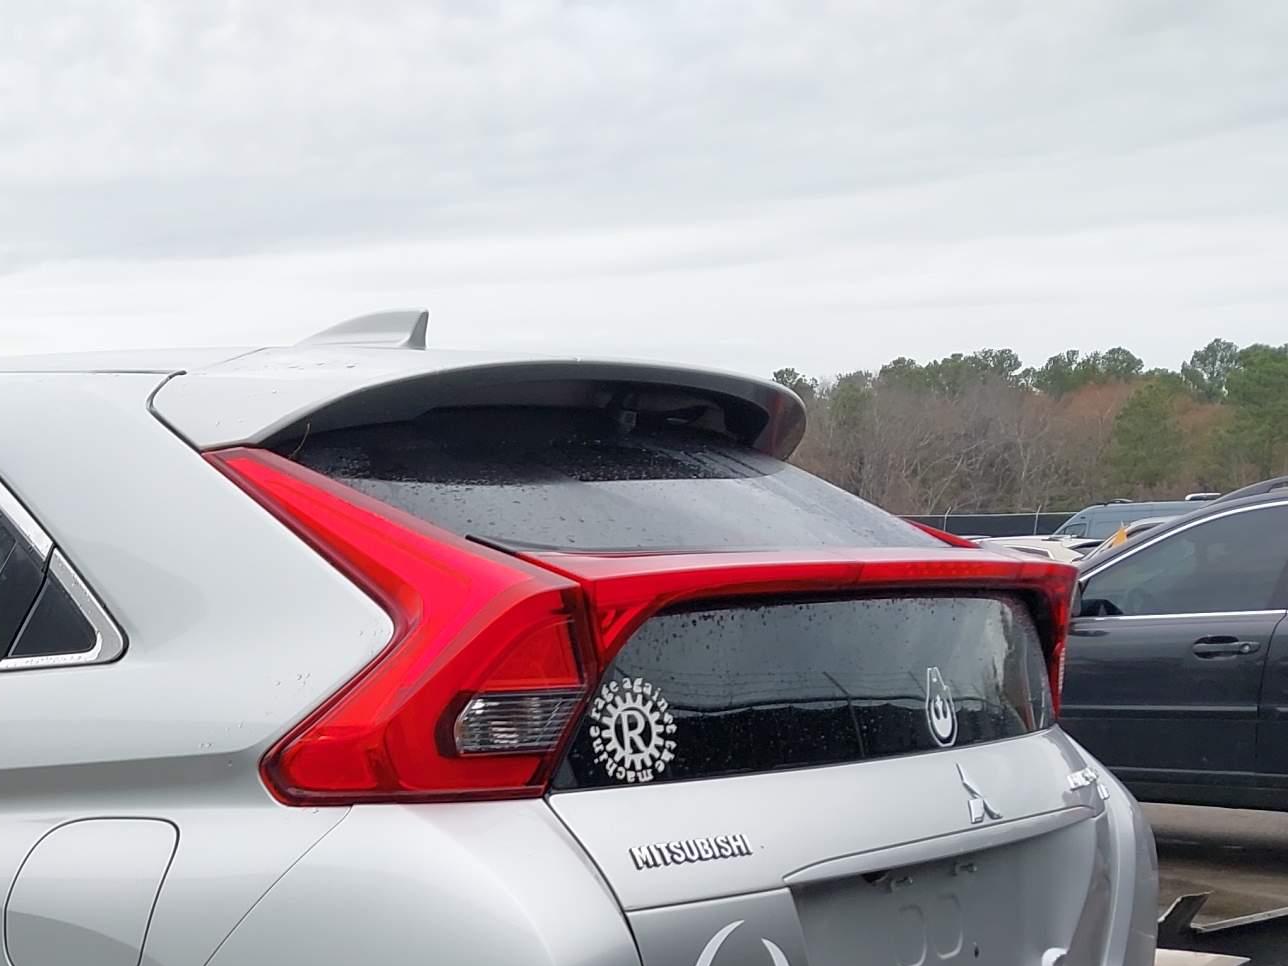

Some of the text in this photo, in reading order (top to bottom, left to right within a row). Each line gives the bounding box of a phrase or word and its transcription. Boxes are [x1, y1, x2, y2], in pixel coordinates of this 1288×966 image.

[589, 677, 677, 783] rage against the machine
[621, 709, 647, 754] R
[628, 834, 753, 871] MITSUBISHI
